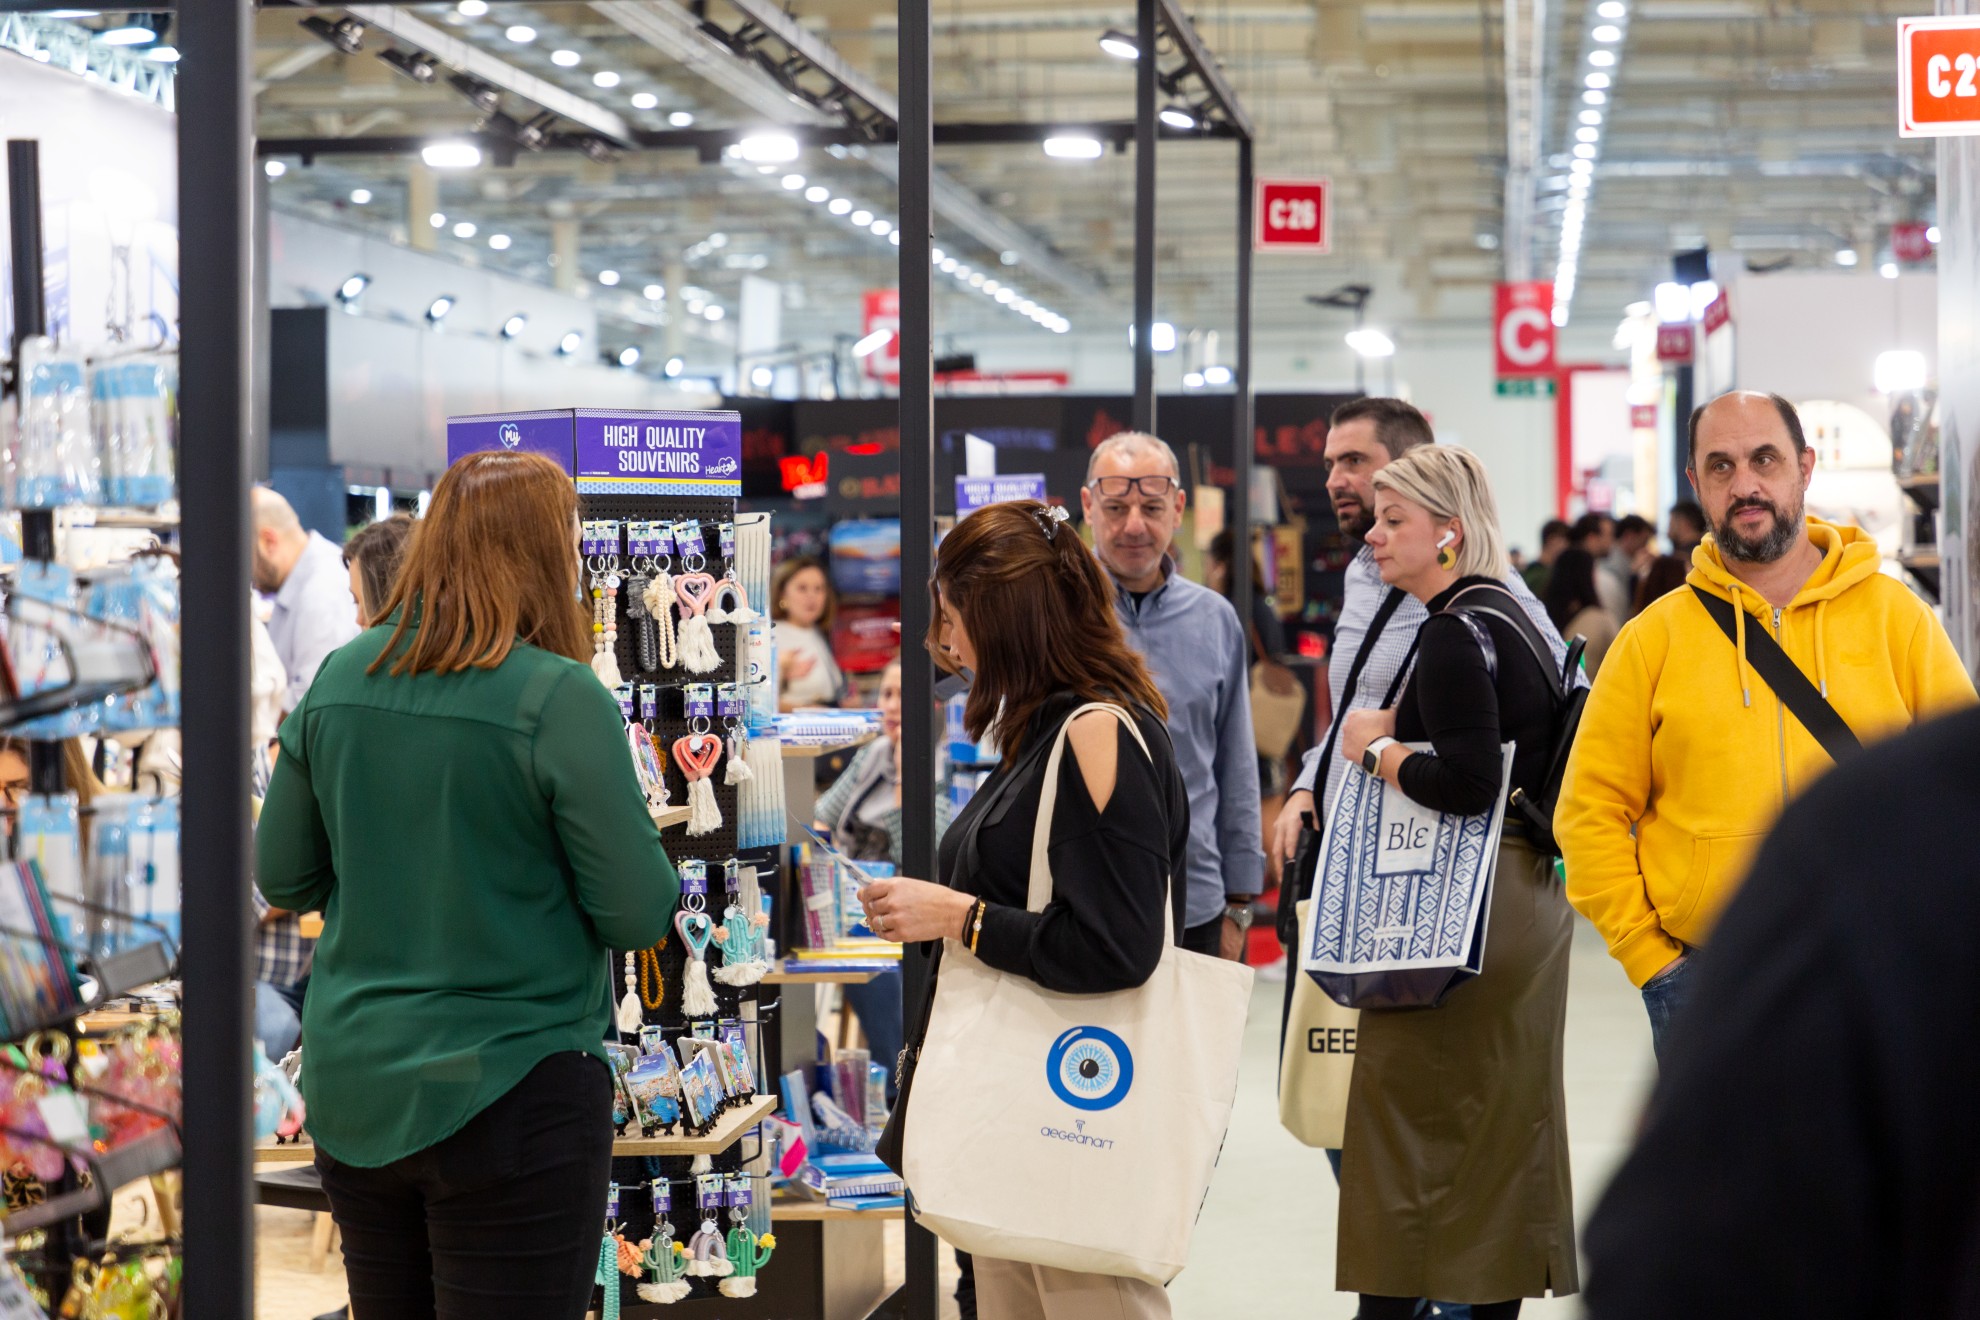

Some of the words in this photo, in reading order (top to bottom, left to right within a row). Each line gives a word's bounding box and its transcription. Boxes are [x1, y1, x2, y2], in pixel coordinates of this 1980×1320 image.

[1928, 53, 1980, 98] C2
[1501, 307, 1548, 366] C
[505, 429, 520, 446] My
[603, 425, 638, 447] HIGH
[646, 427, 706, 449] QUALITY
[618, 450, 700, 474] SOUVENIRS
[1308, 1027, 1356, 1054] GEE
